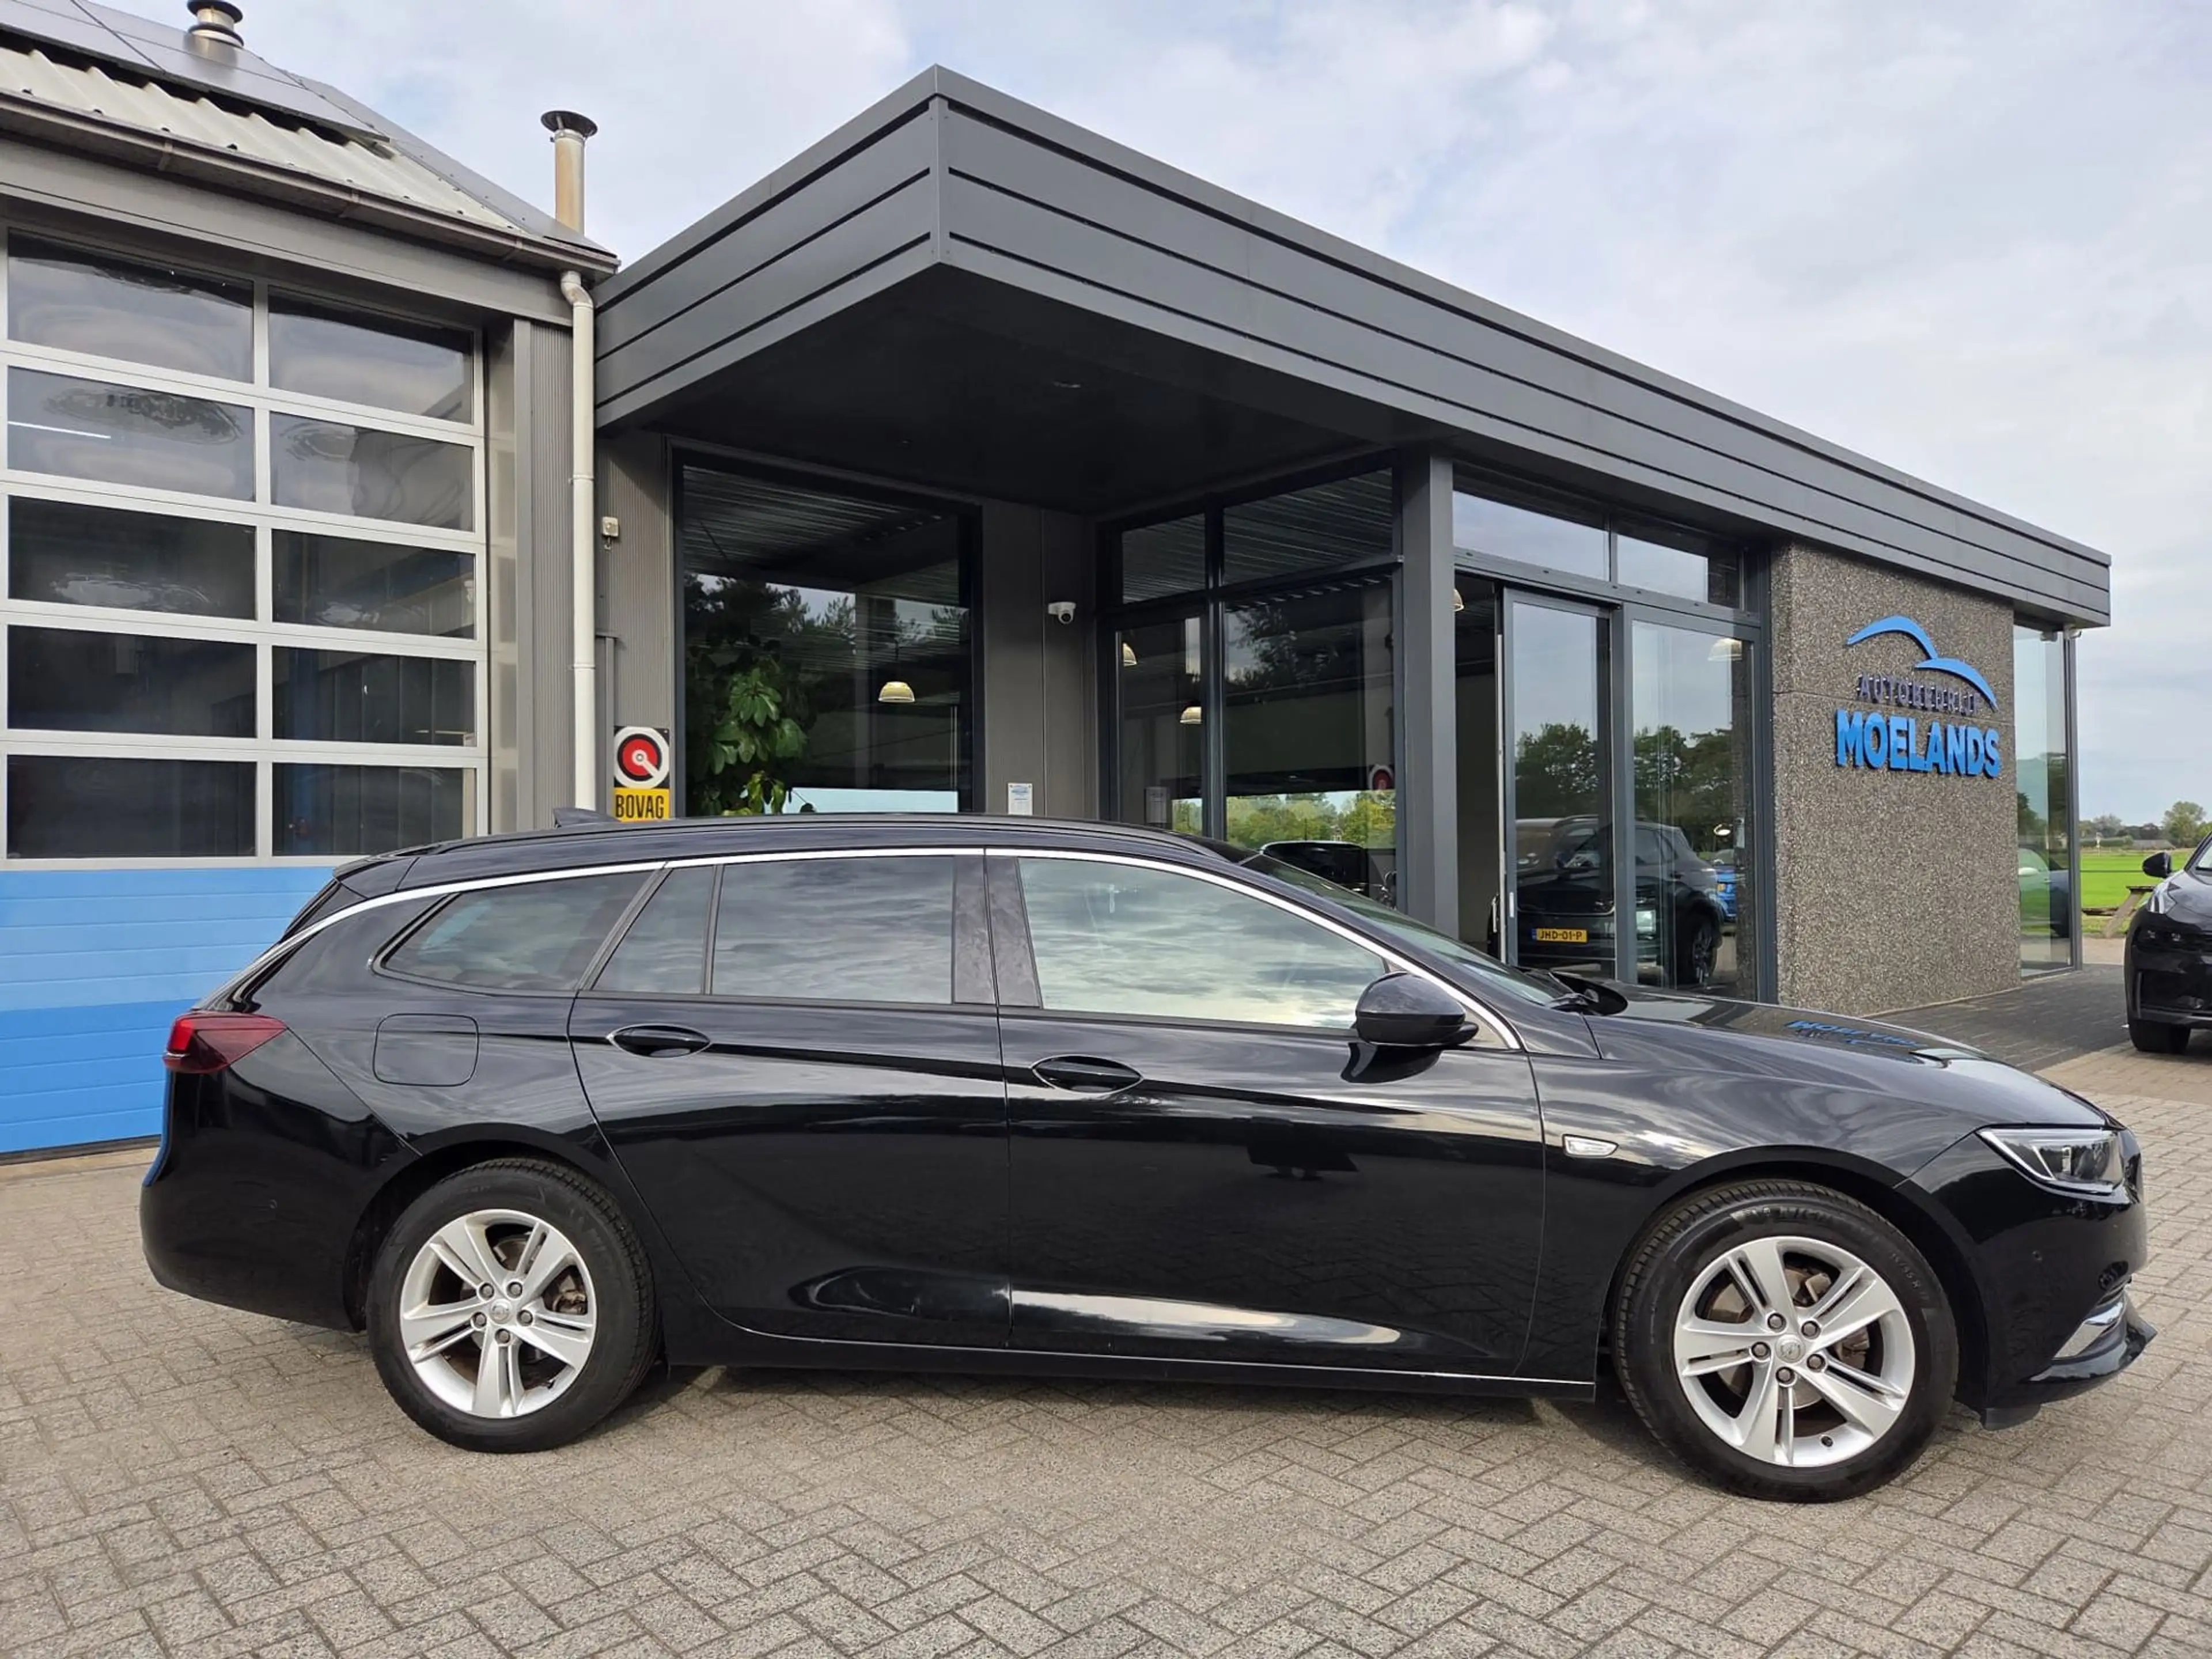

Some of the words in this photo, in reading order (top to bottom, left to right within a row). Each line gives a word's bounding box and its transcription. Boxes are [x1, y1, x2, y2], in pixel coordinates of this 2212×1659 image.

[1835, 709, 2001, 778] MOELANDS
[615, 794, 664, 819] BOVAG
[1539, 929, 1582, 940] JHD-01-P
